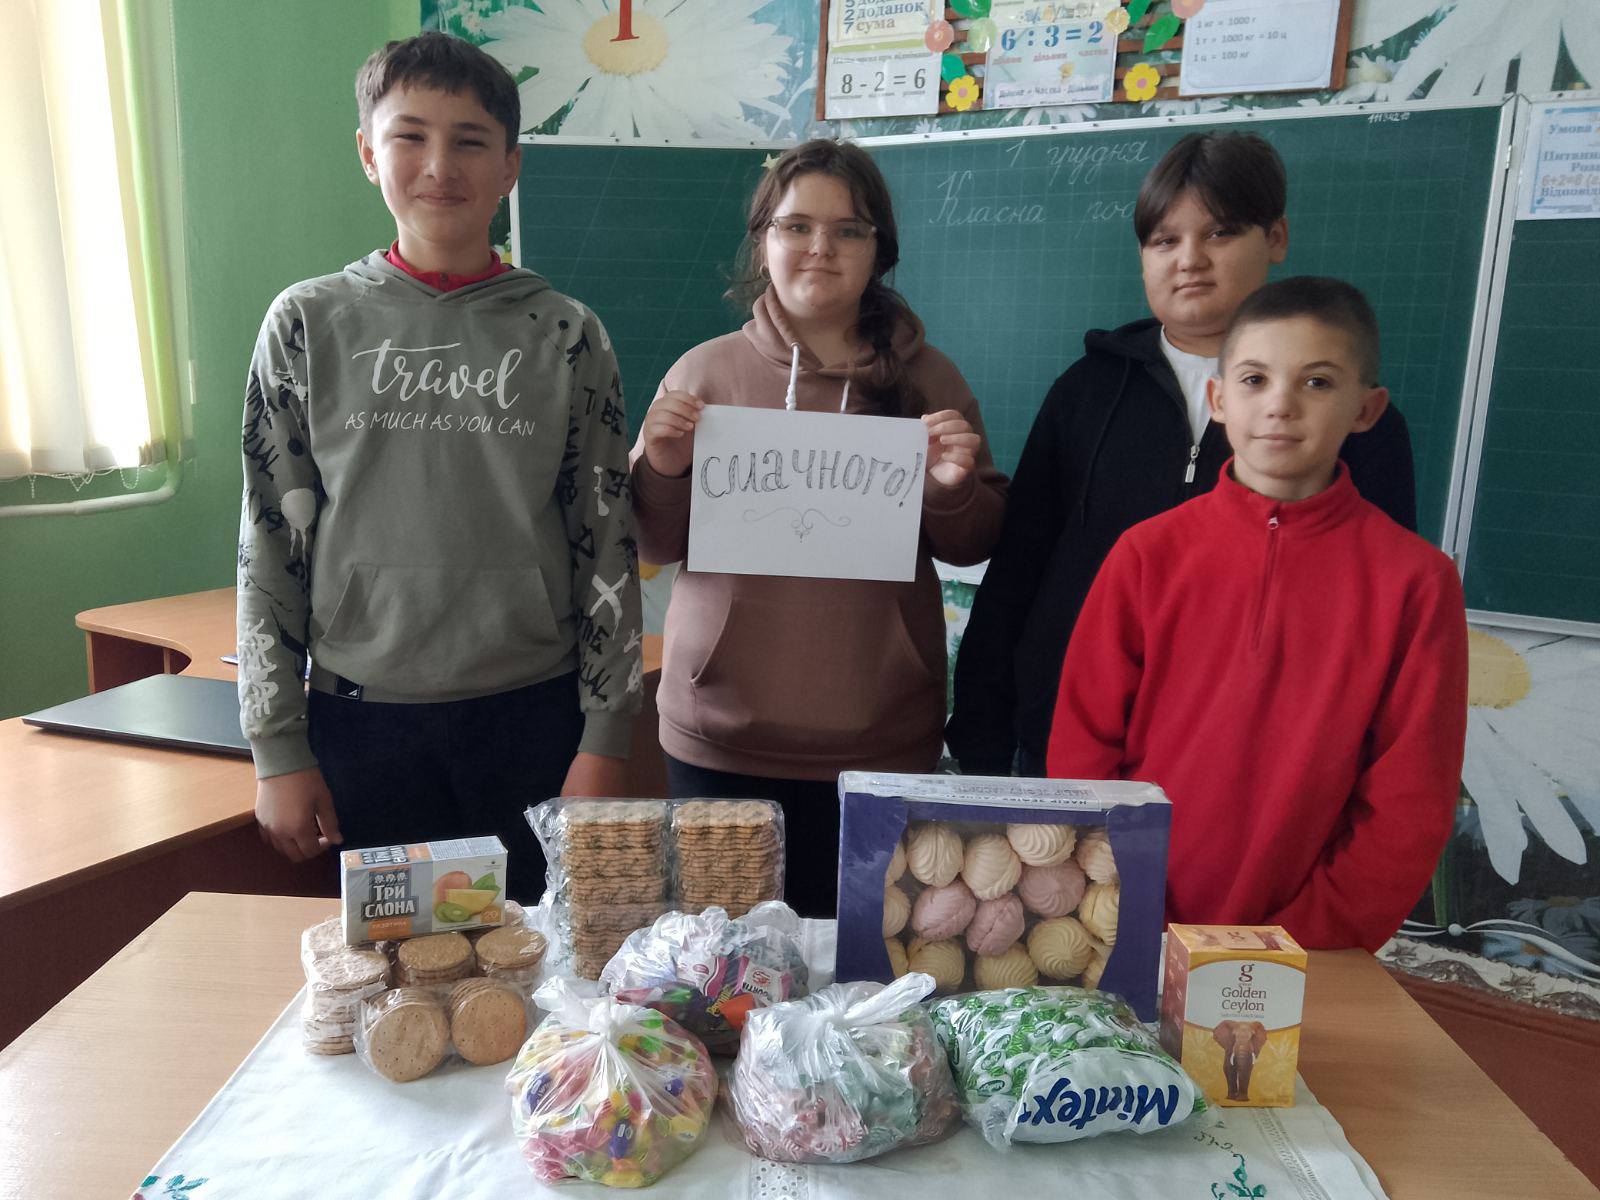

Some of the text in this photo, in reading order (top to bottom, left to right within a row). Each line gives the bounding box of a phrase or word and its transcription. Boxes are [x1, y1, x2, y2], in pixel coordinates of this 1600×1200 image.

[844, 2, 924, 21] 2 доданок
[844, 18, 896, 34] 7 сума
[1001, 29, 1016, 51] 6
[1044, 25, 1060, 47] 3
[1087, 21, 1103, 43] 2
[841, 73, 853, 94] 8
[874, 71, 885, 92] 2
[914, 68, 926, 89] 6
[1549, 124, 1592, 135] Умова
[1006, 139, 1149, 186] 1 грудня
[929, 170, 1047, 226] Класна
[352, 339, 523, 410] travel
[345, 411, 536, 436] AS MUCH AS YOU CAN
[373, 884, 405, 901] ТРИ
[365, 900, 416, 918] СЛОНА
[1238, 962, 1255, 983] g
[1221, 986, 1267, 999] Golden
[1221, 1000, 1265, 1014] Ceylon
